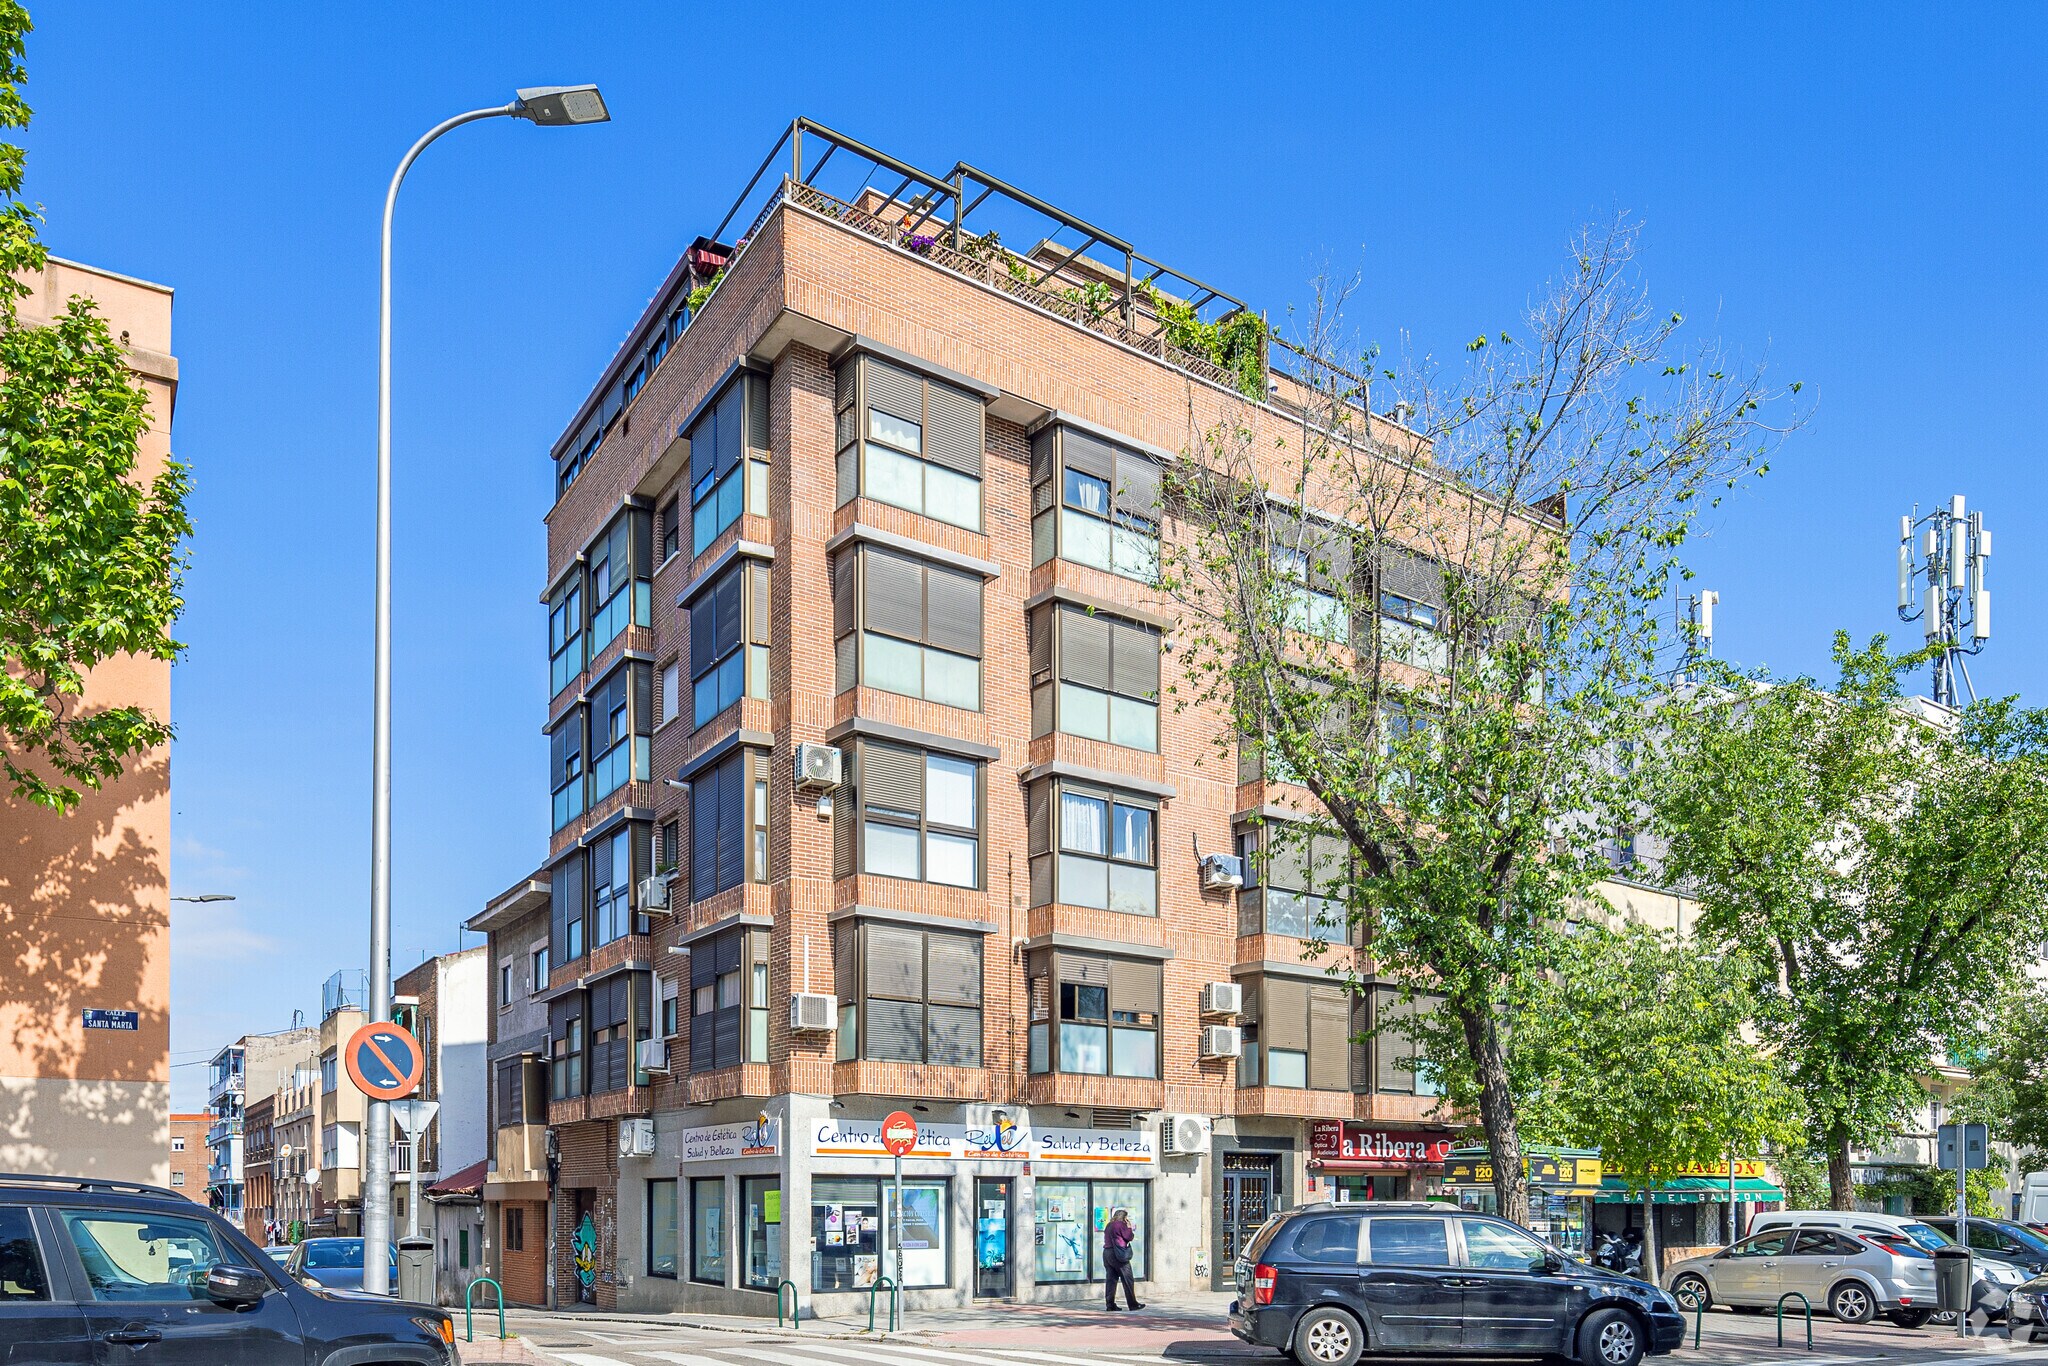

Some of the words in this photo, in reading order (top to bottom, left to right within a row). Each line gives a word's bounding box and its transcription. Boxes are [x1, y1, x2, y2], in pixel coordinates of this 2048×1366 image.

[88, 1020, 109, 1028] SANTA
[111, 1021, 133, 1029] MARTA
[1321, 1124, 1339, 1132] Ribera
[685, 1132, 704, 1144] Centro
[704, 1130, 711, 1141] de
[712, 1128, 737, 1141] Estética
[818, 1126, 869, 1143] Centro
[873, 1128, 884, 1143] d
[918, 1129, 951, 1146] ética
[1041, 1135, 1082, 1150] Salud
[1085, 1139, 1094, 1153] y
[1099, 1137, 1151, 1152] Belleza
[1342, 1139, 1355, 1157] a
[1358, 1132, 1427, 1159] Ribera
[687, 1148, 704, 1158] Salud
[704, 1150, 709, 1159] y
[710, 1145, 735, 1156] Belleza
[1475, 1167, 1493, 1178] 120
[1559, 1167, 1573, 1178] 120
[1623, 1193, 1656, 1201] BAR
[1699, 1192, 1762, 1201] GALEON
